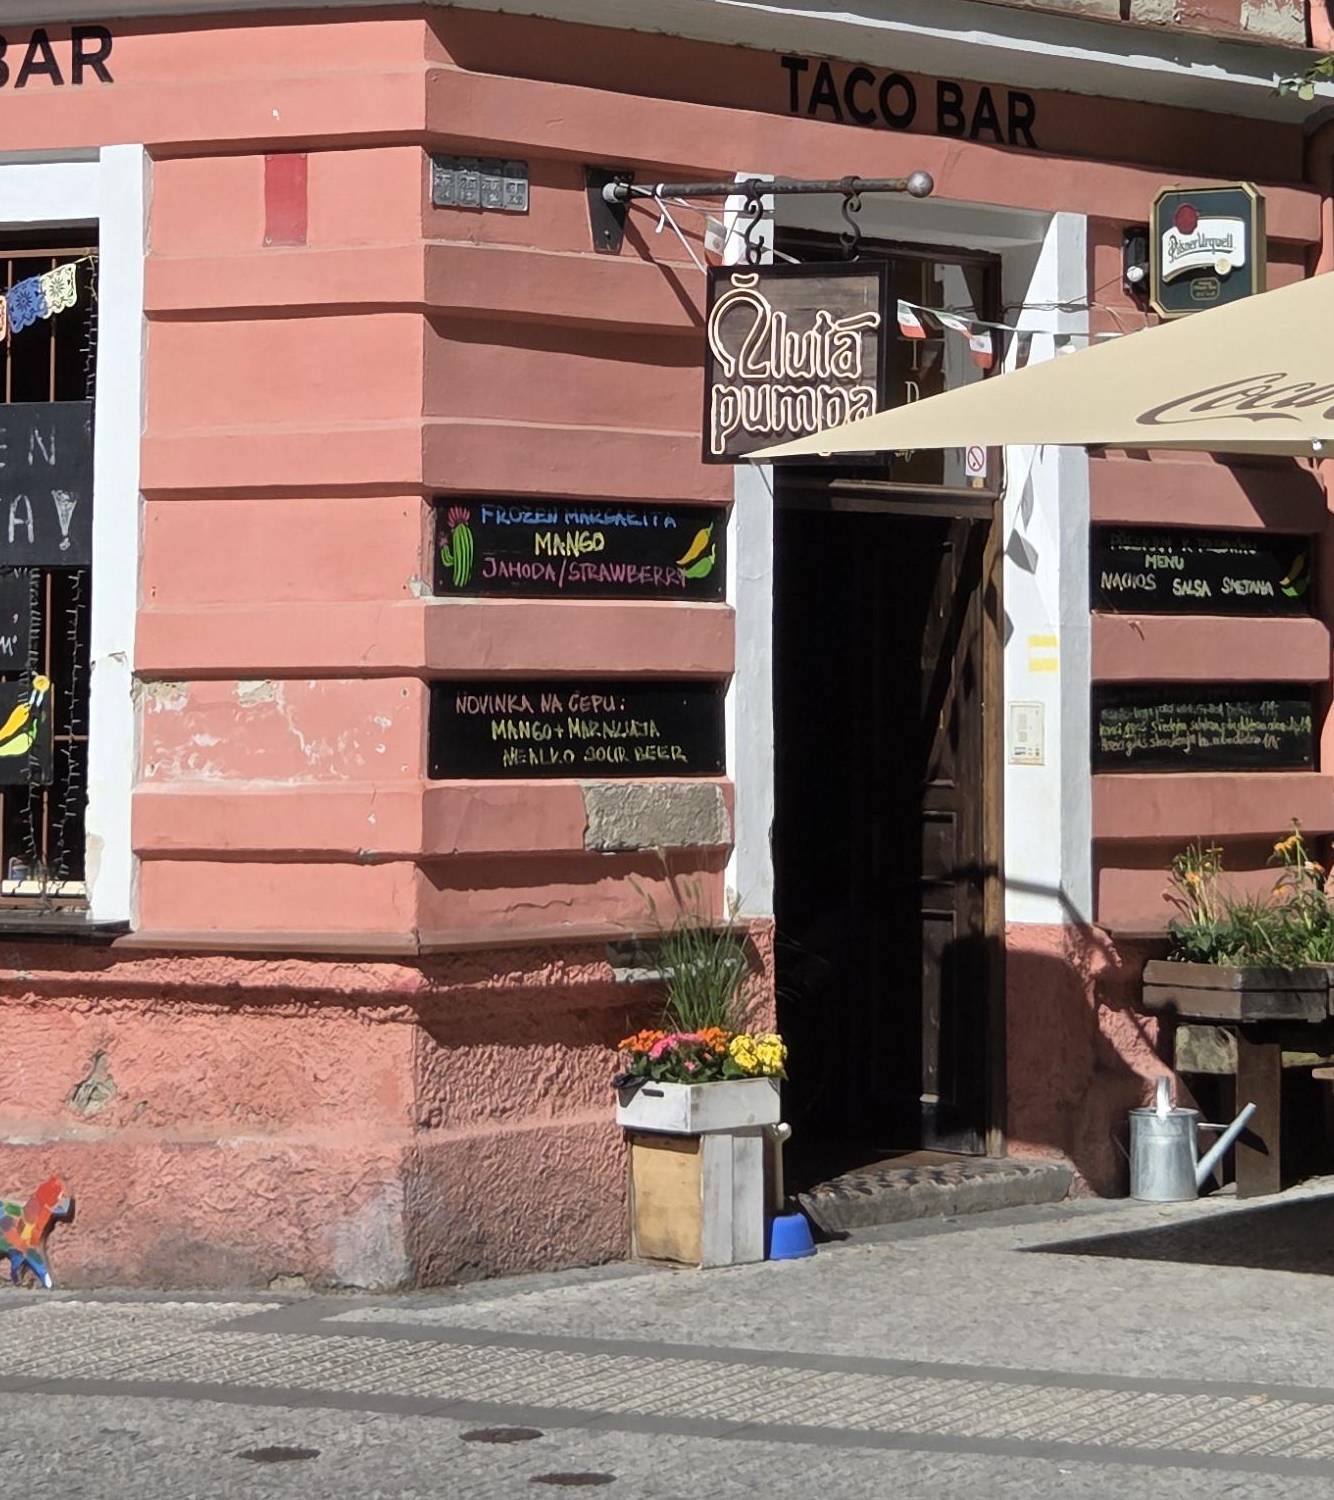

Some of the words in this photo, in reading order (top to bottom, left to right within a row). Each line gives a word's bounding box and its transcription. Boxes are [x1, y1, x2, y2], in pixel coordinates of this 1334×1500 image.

[781, 56, 917, 130] TACO
[936, 80, 1038, 149] BAR
[534, 530, 606, 557] MANGO
[1144, 554, 1185, 570] MENU
[1172, 578, 1211, 597] SALSA
[455, 693, 535, 715] NOVINKA
[540, 693, 563, 713] NA
[635, 745, 689, 764] BEER
